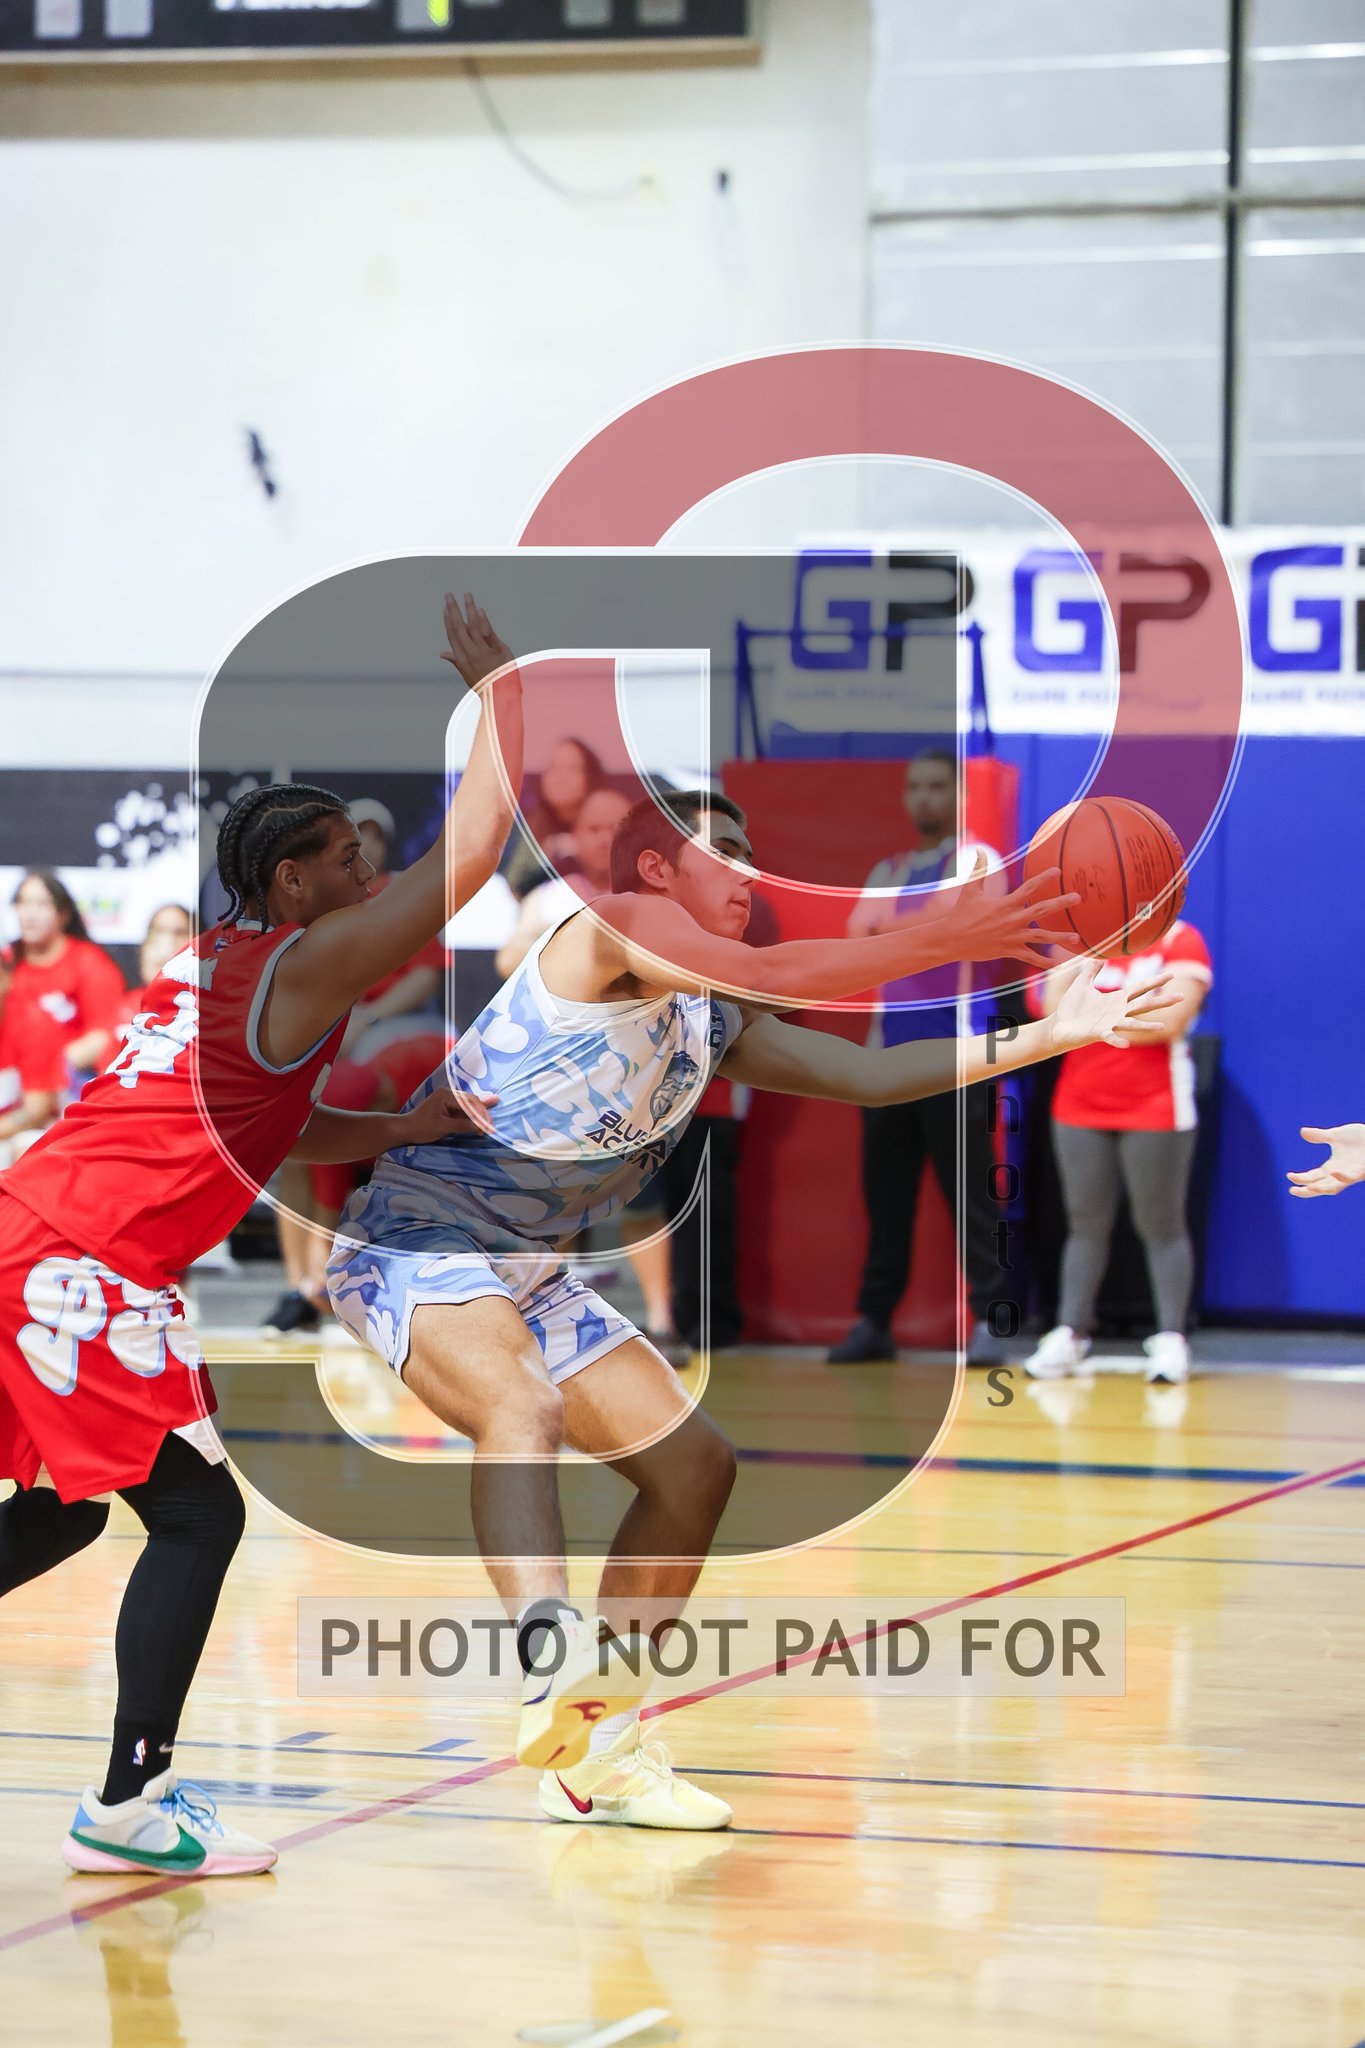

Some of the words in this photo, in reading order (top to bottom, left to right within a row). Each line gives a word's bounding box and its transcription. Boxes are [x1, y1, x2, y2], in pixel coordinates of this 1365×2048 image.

[791, 549, 975, 671] GP
[1013, 551, 1211, 672] GP
[1249, 545, 1365, 672] G
